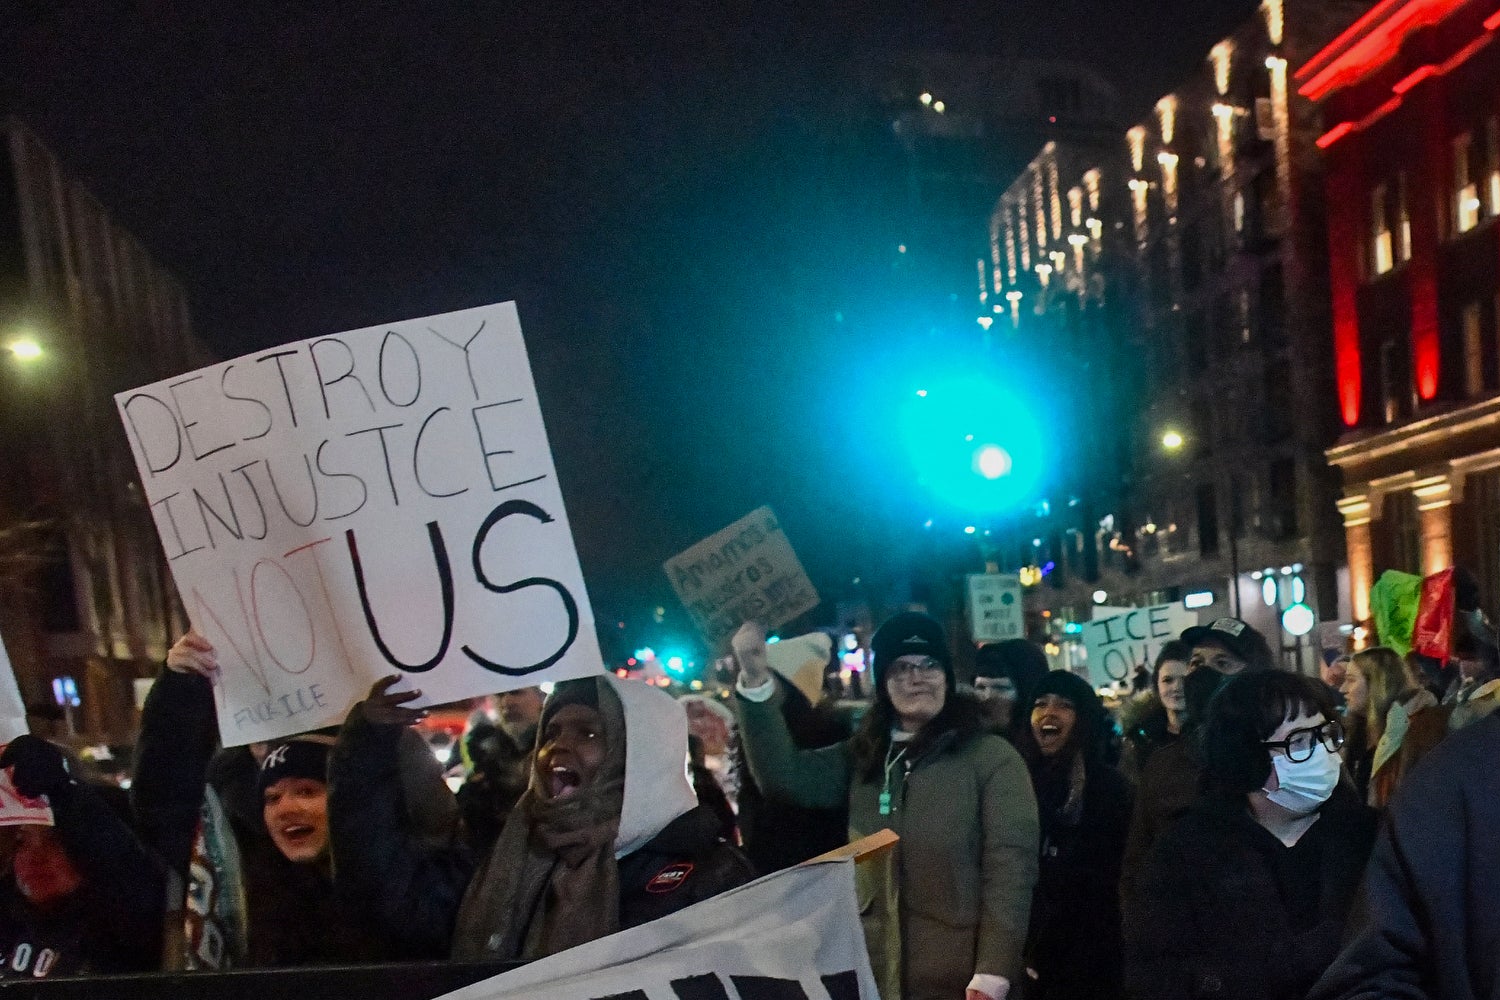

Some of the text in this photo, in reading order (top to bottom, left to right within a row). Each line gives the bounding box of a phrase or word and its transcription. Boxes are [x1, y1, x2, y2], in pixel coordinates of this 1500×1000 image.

[123, 320, 486, 478] DESTROY
[152, 398, 547, 561] INJUSTCE
[191, 499, 580, 708] NOT US
[1092, 606, 1170, 647] ICE
